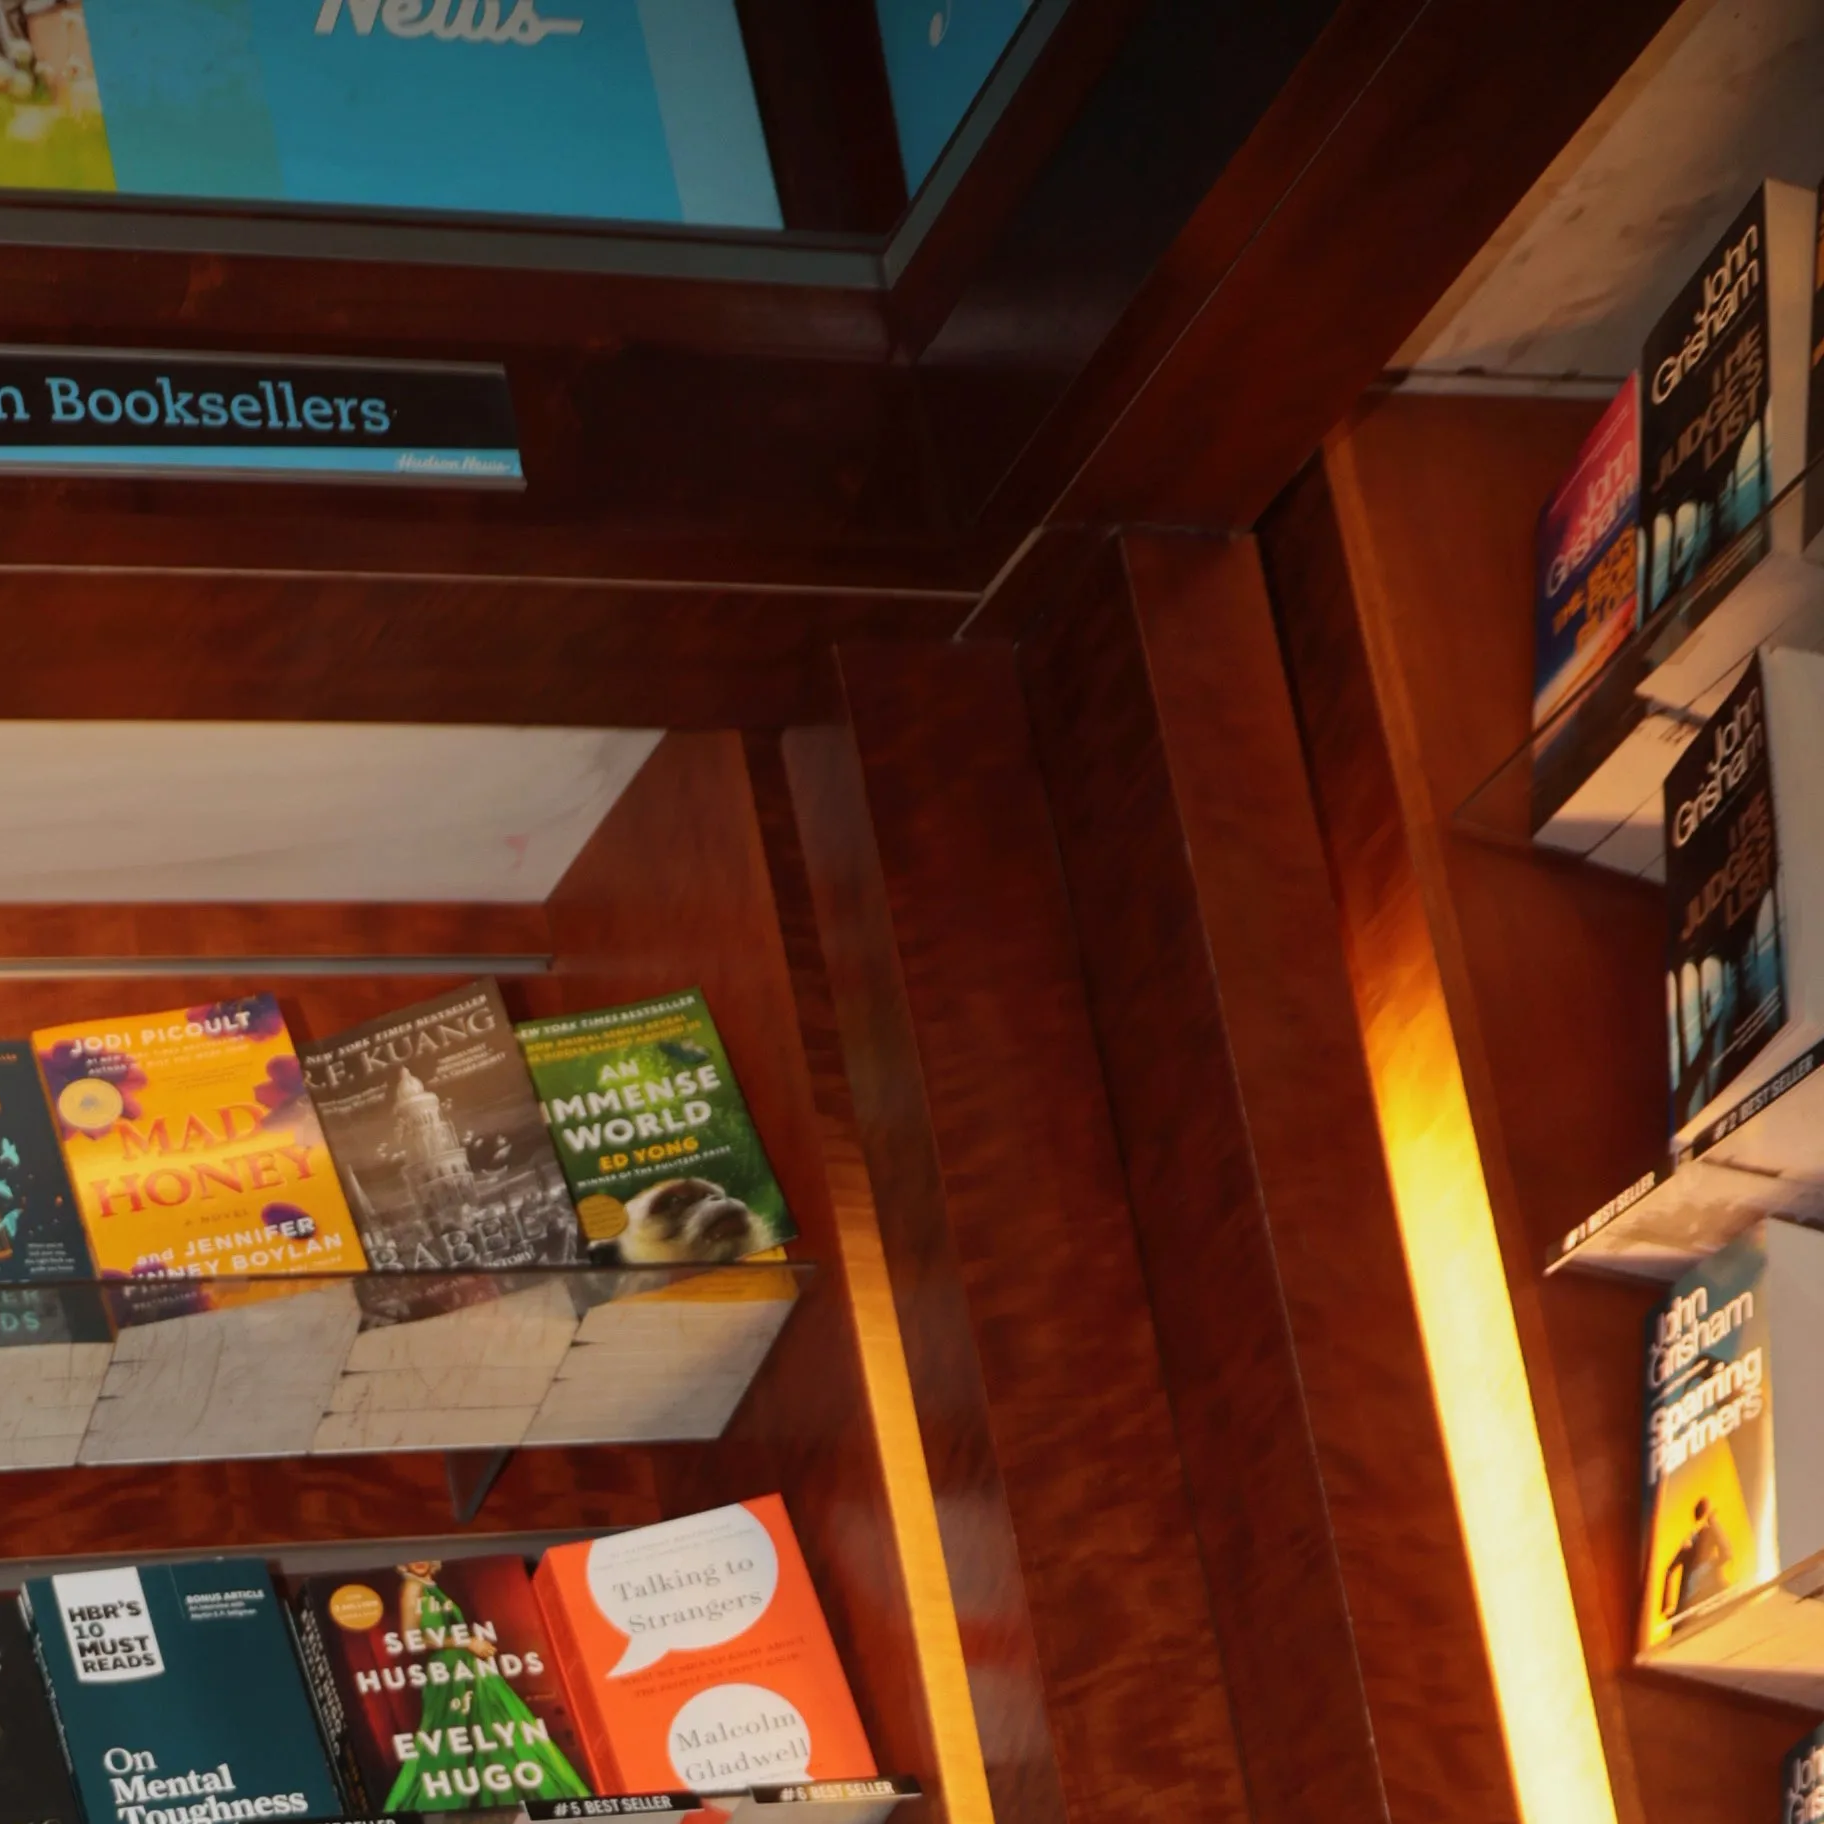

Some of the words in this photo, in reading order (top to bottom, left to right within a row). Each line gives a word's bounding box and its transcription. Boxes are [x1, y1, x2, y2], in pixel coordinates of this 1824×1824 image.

[1650, 255, 1760, 408] Grisham
[47, 376, 394, 434] Booksellers
[116, 1101, 270, 1162] MAD
[564, 1100, 713, 1154] WORLD
[598, 1149, 630, 1171] ED
[637, 1136, 698, 1165] YONG
[95, 1144, 318, 1218] HONEY
[612, 1562, 719, 1605] Talking
[726, 1556, 754, 1577] to
[67, 1600, 142, 1625] HBR'S
[73, 1623, 103, 1640] 10
[626, 1587, 763, 1639] Strangers
[77, 1635, 151, 1656] MUST
[383, 1621, 499, 1656] SEVEN
[81, 1651, 157, 1674] READS
[355, 1652, 544, 1694] HUSBANDS
[392, 1718, 550, 1760] EVELYN
[675, 1707, 798, 1752] Malcolm
[104, 1748, 157, 1776] On
[421, 1760, 545, 1798] HUGO
[683, 1739, 811, 1785] Gladwell
[108, 1765, 236, 1804] Mental
